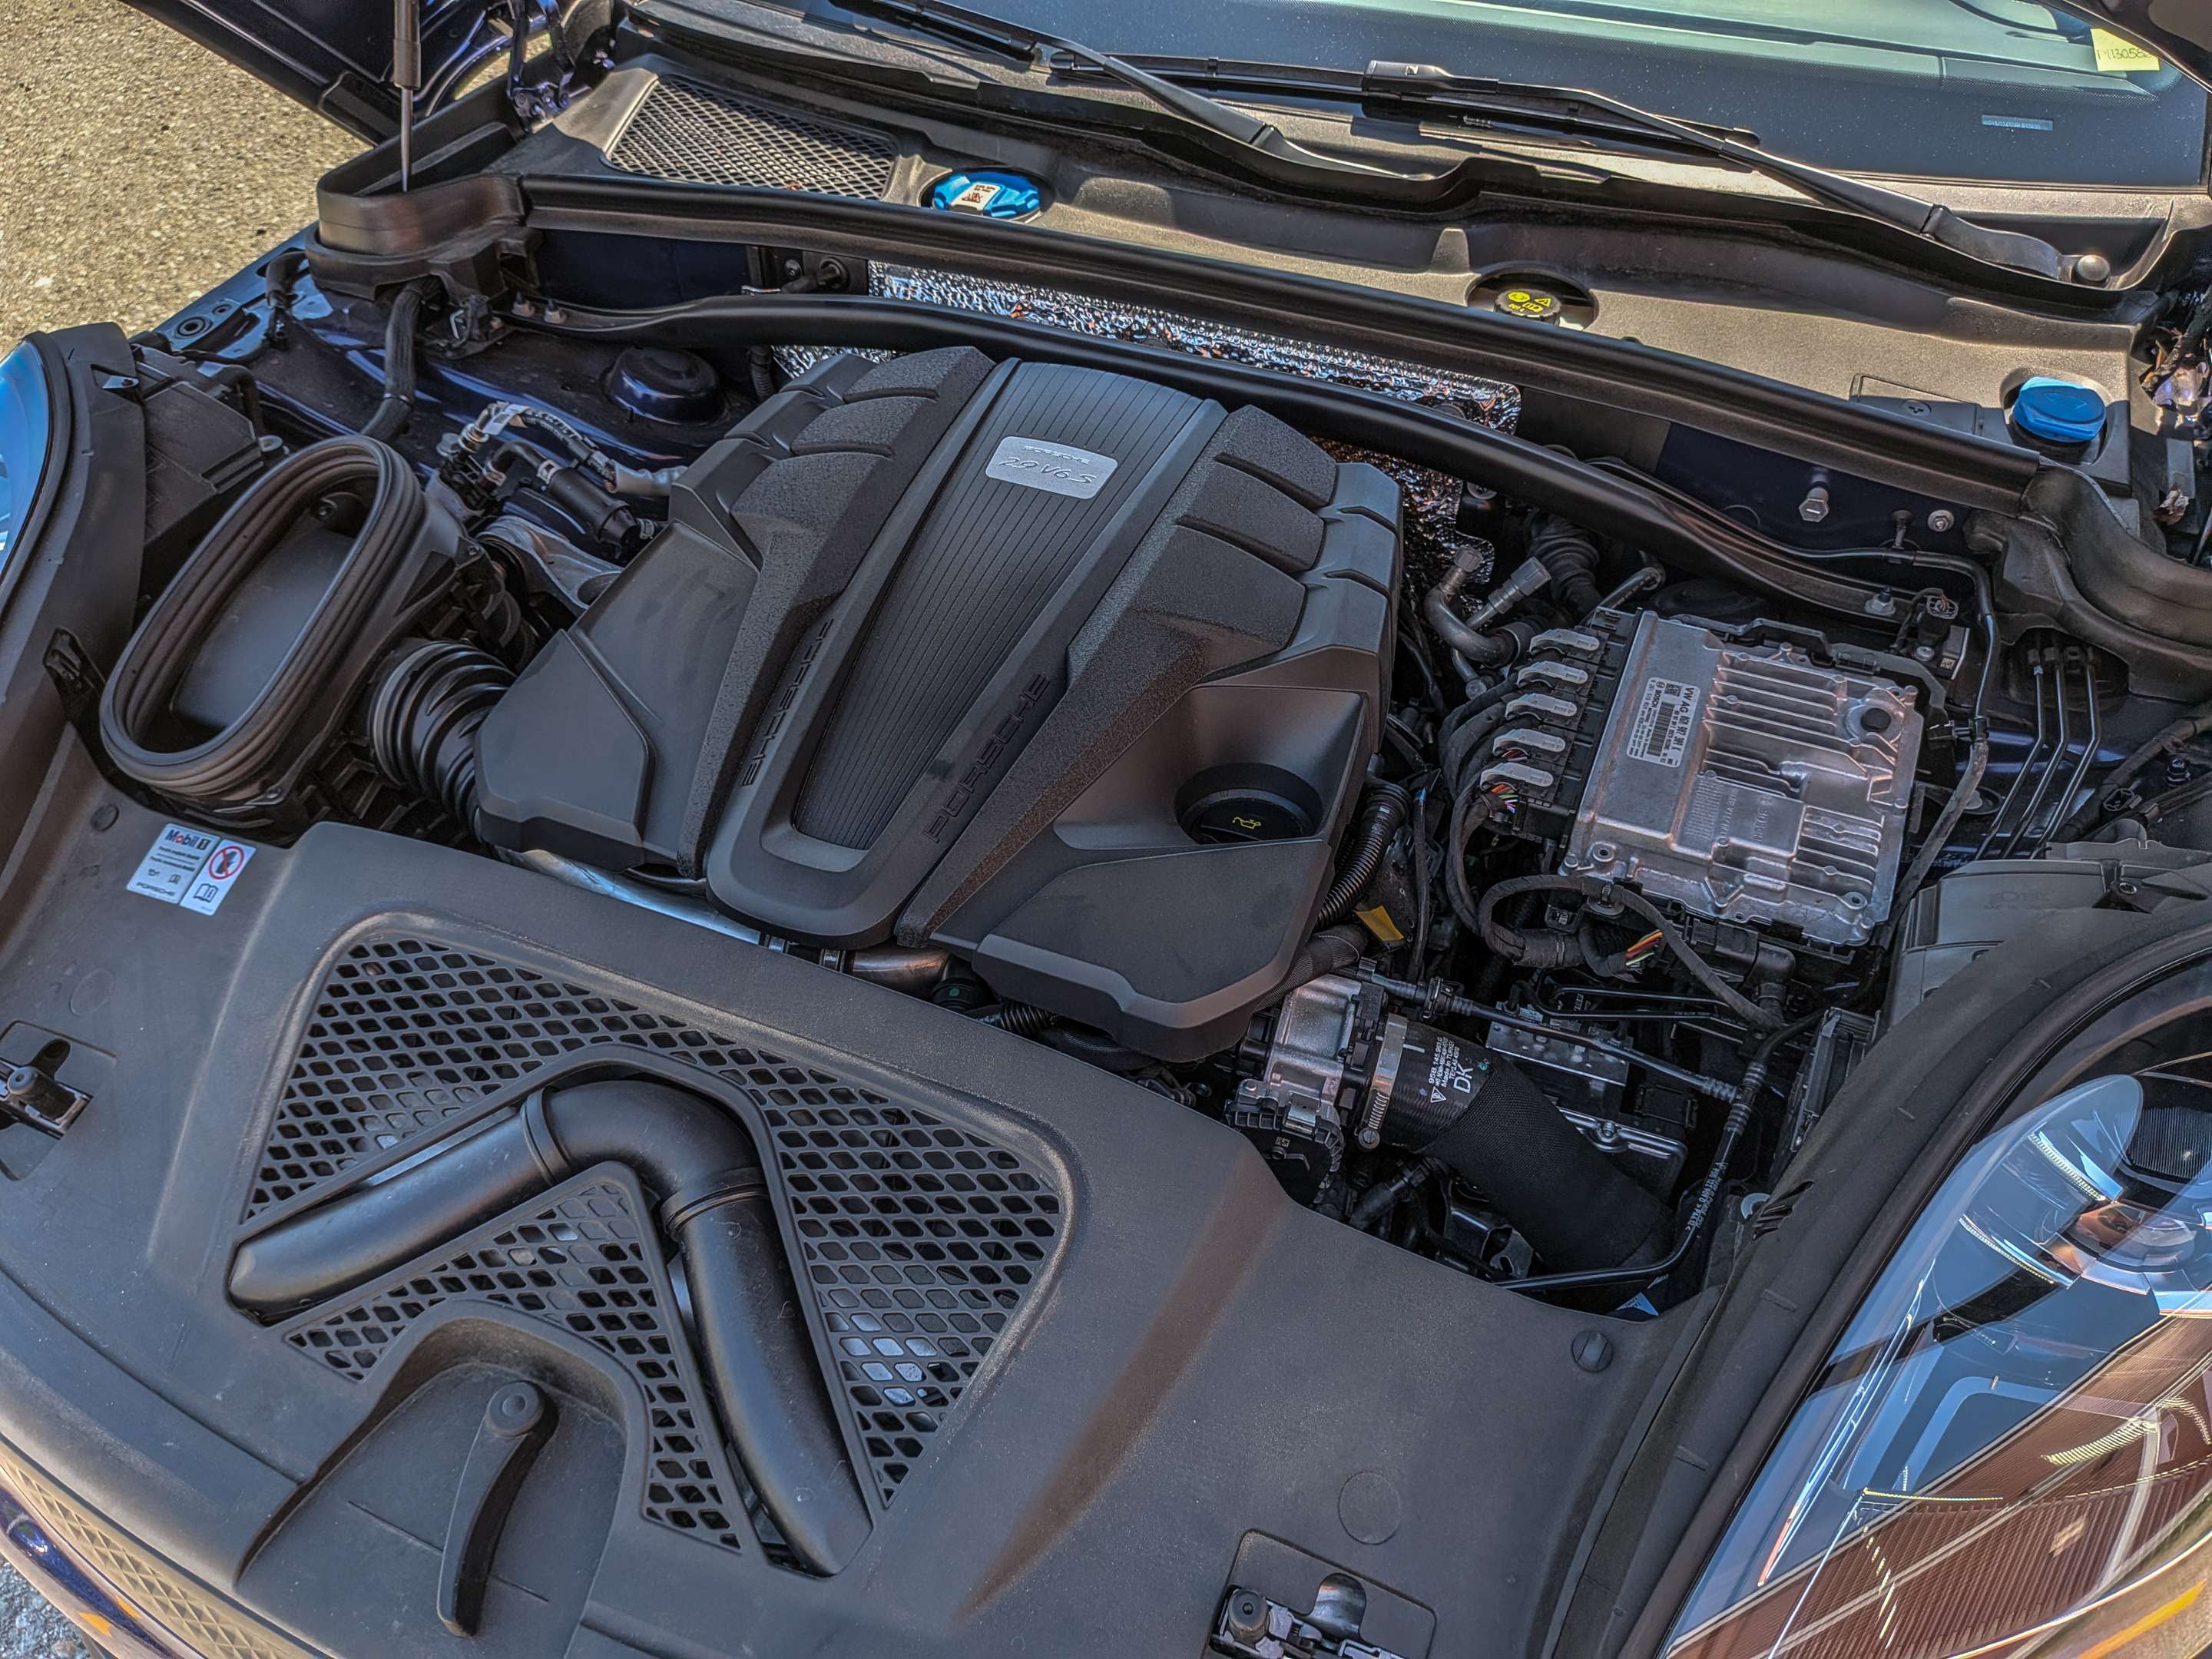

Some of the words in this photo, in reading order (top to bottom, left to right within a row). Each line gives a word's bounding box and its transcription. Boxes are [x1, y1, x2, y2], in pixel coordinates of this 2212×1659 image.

[1022, 445, 1090, 465] PORSCHE
[1041, 463, 1072, 479] V6
[741, 618, 835, 787] PORSCHE
[1651, 690, 1662, 707] BOSCH
[1684, 687, 1695, 700] VW
[1679, 700, 1690, 713] AG
[923, 673, 1051, 844] PORSCHE
[164, 829, 200, 848] Mobil
[136, 882, 176, 897] PORSCHE
[1441, 1068, 1451, 1088] Made
[1453, 1063, 1474, 1094] DK
